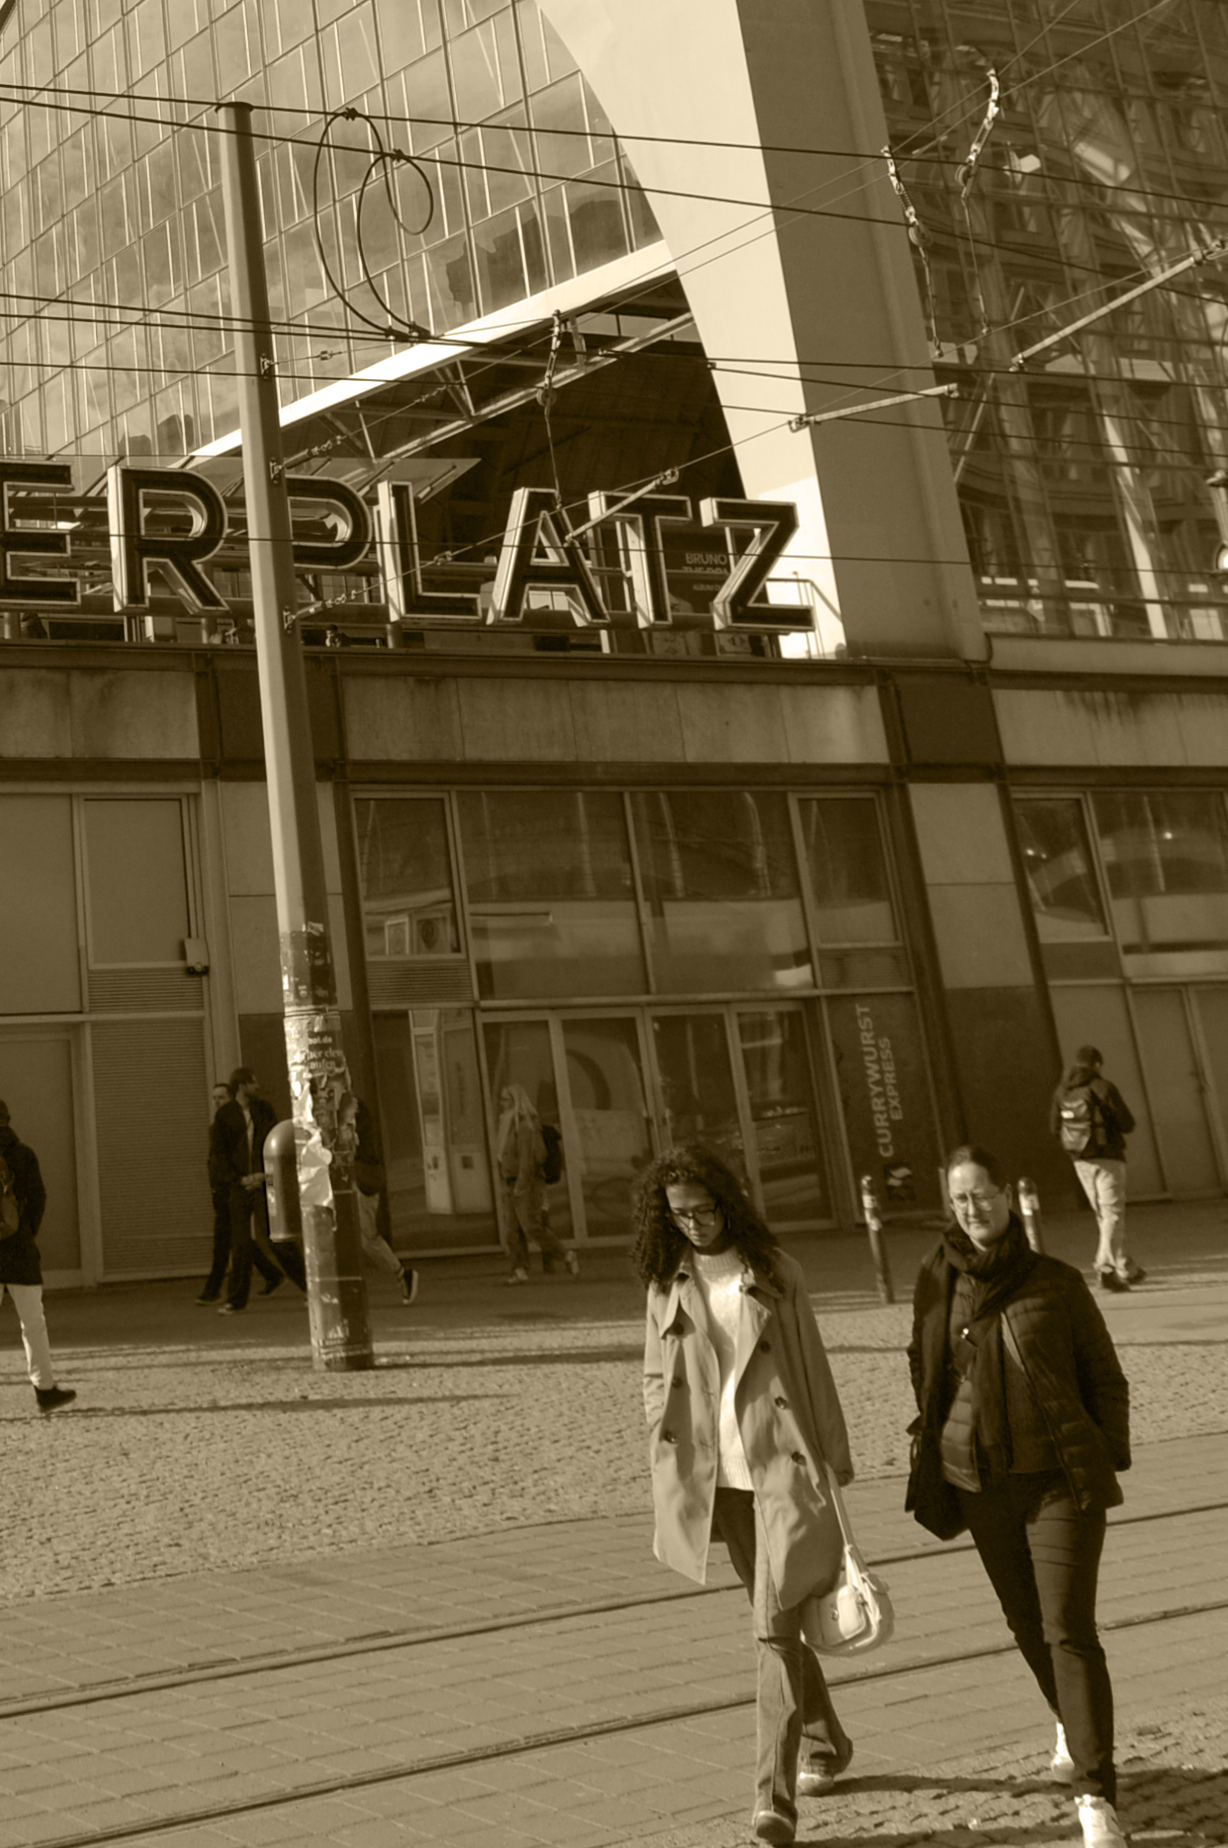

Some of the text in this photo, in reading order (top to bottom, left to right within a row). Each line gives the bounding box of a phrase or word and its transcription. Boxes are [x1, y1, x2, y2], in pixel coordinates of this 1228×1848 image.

[685, 552, 728, 565] BRUNO
[693, 583, 714, 592] ALBUM
[855, 1002, 894, 1158] CURRYWURST
[878, 1036, 903, 1121] EXPRESS
